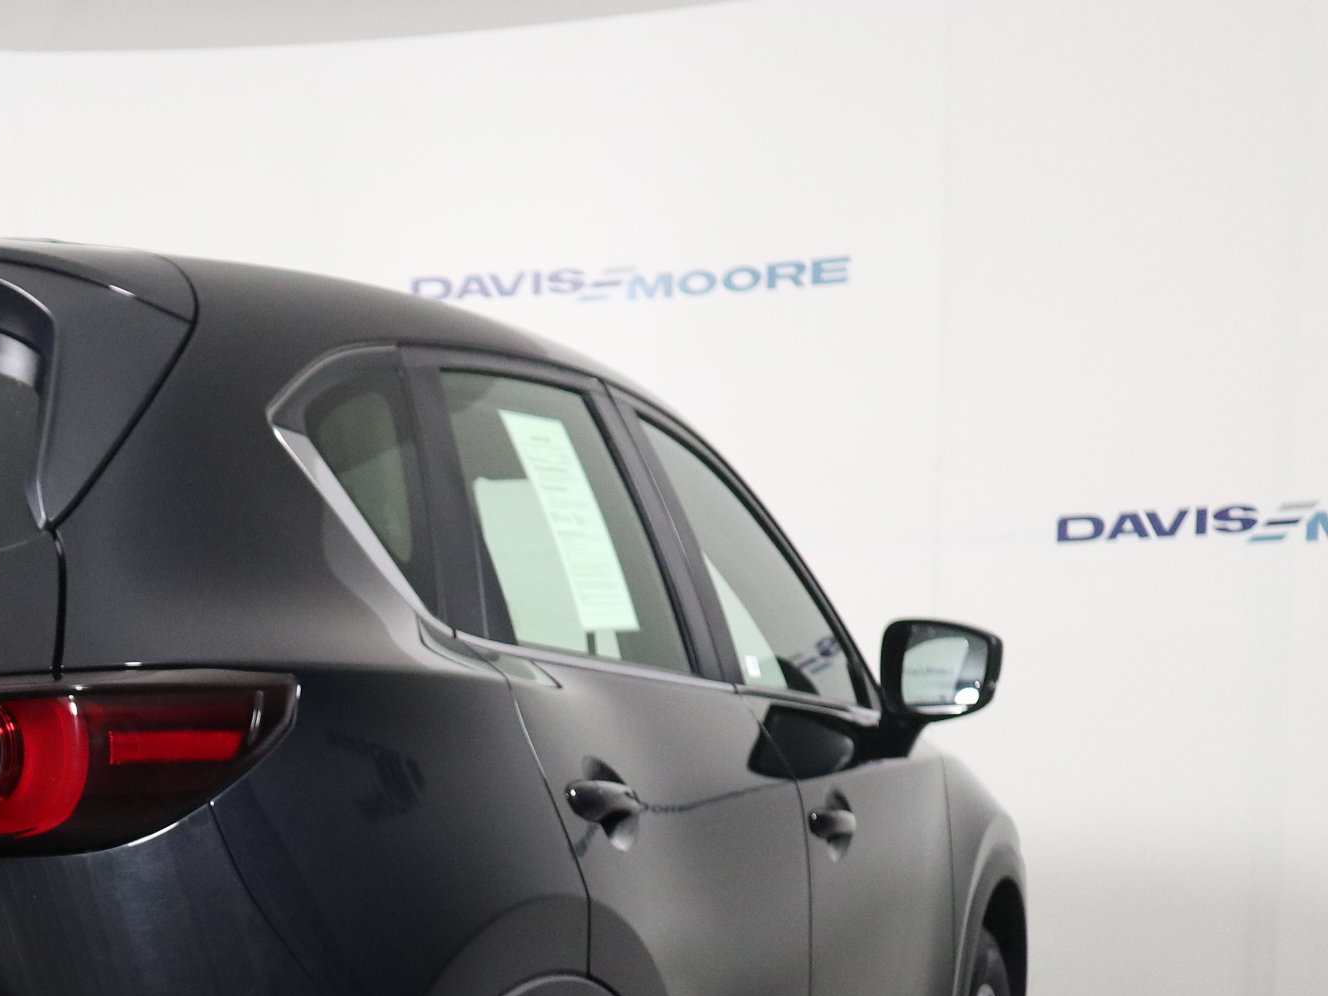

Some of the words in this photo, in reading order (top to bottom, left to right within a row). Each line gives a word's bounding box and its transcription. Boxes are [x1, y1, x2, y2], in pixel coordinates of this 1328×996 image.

[411, 268, 586, 301] DAVIS
[627, 255, 851, 301] MOORE
[1056, 505, 1259, 542] DAVIS
